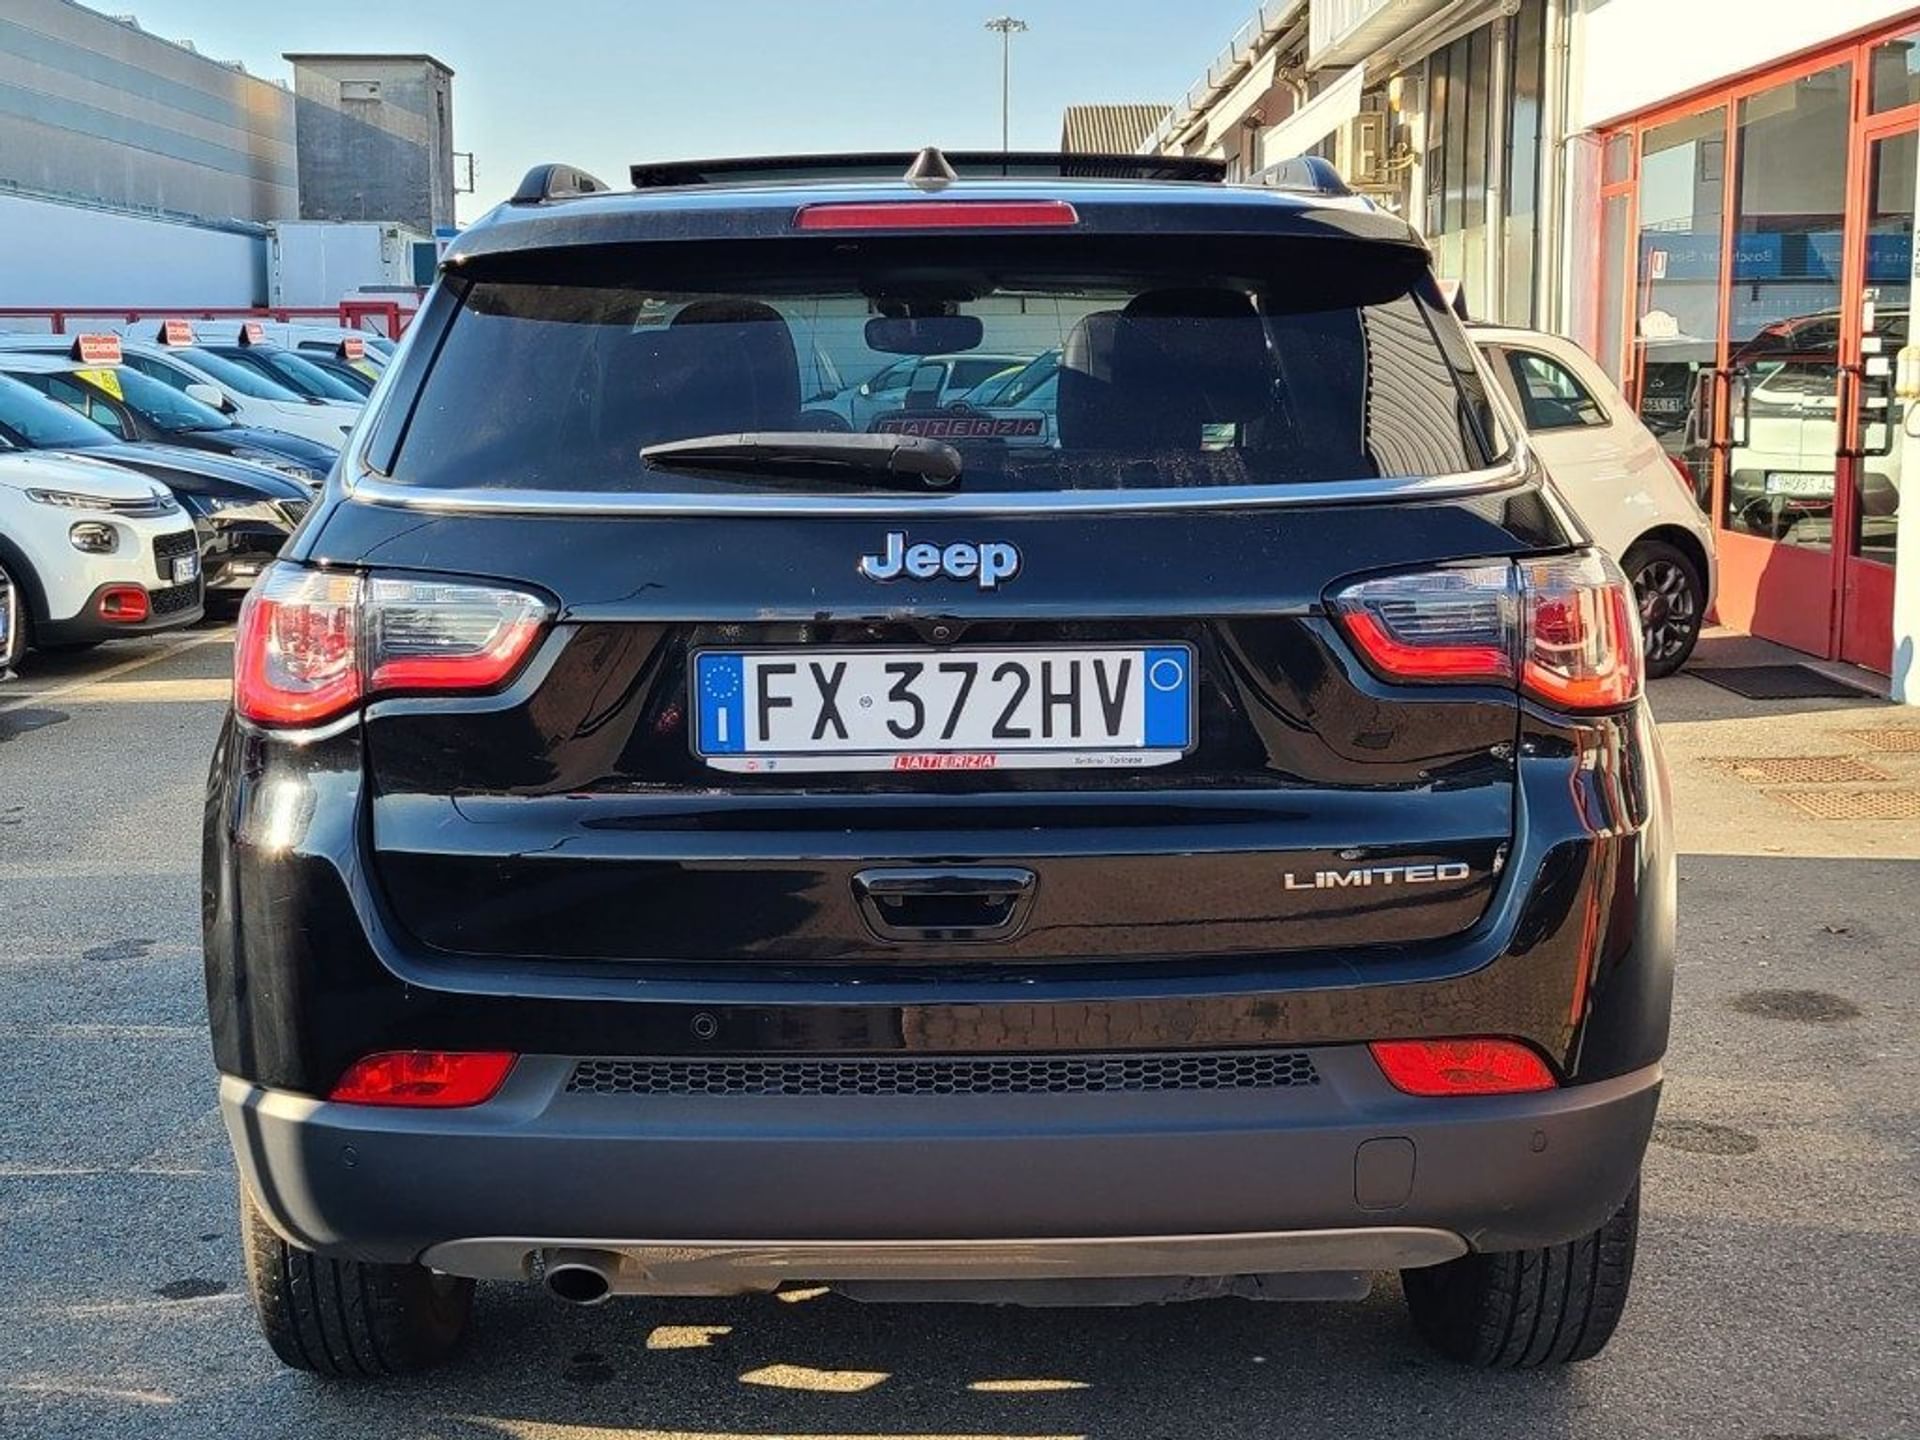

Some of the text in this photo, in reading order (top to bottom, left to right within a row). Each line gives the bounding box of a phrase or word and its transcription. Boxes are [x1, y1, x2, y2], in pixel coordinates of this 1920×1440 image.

[862, 532, 1018, 587] Jeep
[757, 658, 1132, 741] FX 372HV
[718, 707, 728, 742] I
[895, 755, 995, 769] LATERZA
[1284, 862, 1470, 890] LIMITED
